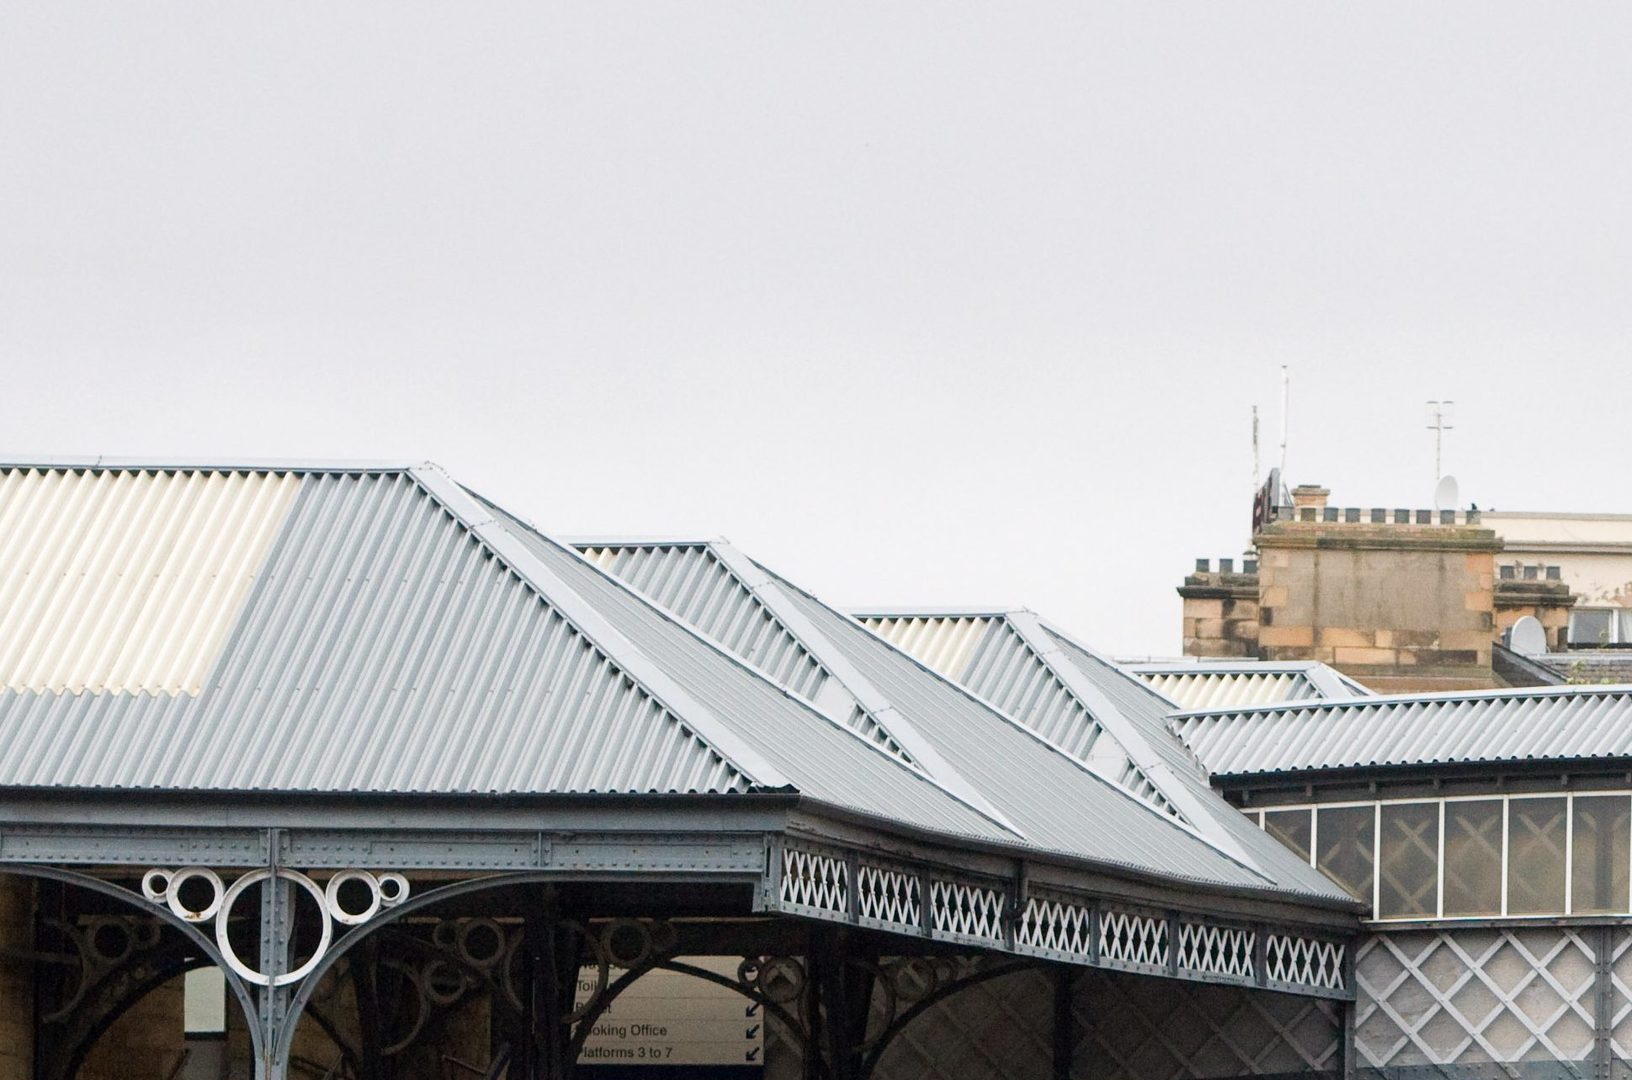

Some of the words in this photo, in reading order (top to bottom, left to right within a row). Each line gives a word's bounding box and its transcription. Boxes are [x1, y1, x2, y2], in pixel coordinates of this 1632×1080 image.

[591, 1024, 627, 1039] oking
[631, 1024, 668, 1036] Office
[583, 1046, 634, 1058] latforms
[638, 1046, 646, 1058] 3
[649, 1047, 661, 1058] to
[665, 1047, 673, 1058] 7
